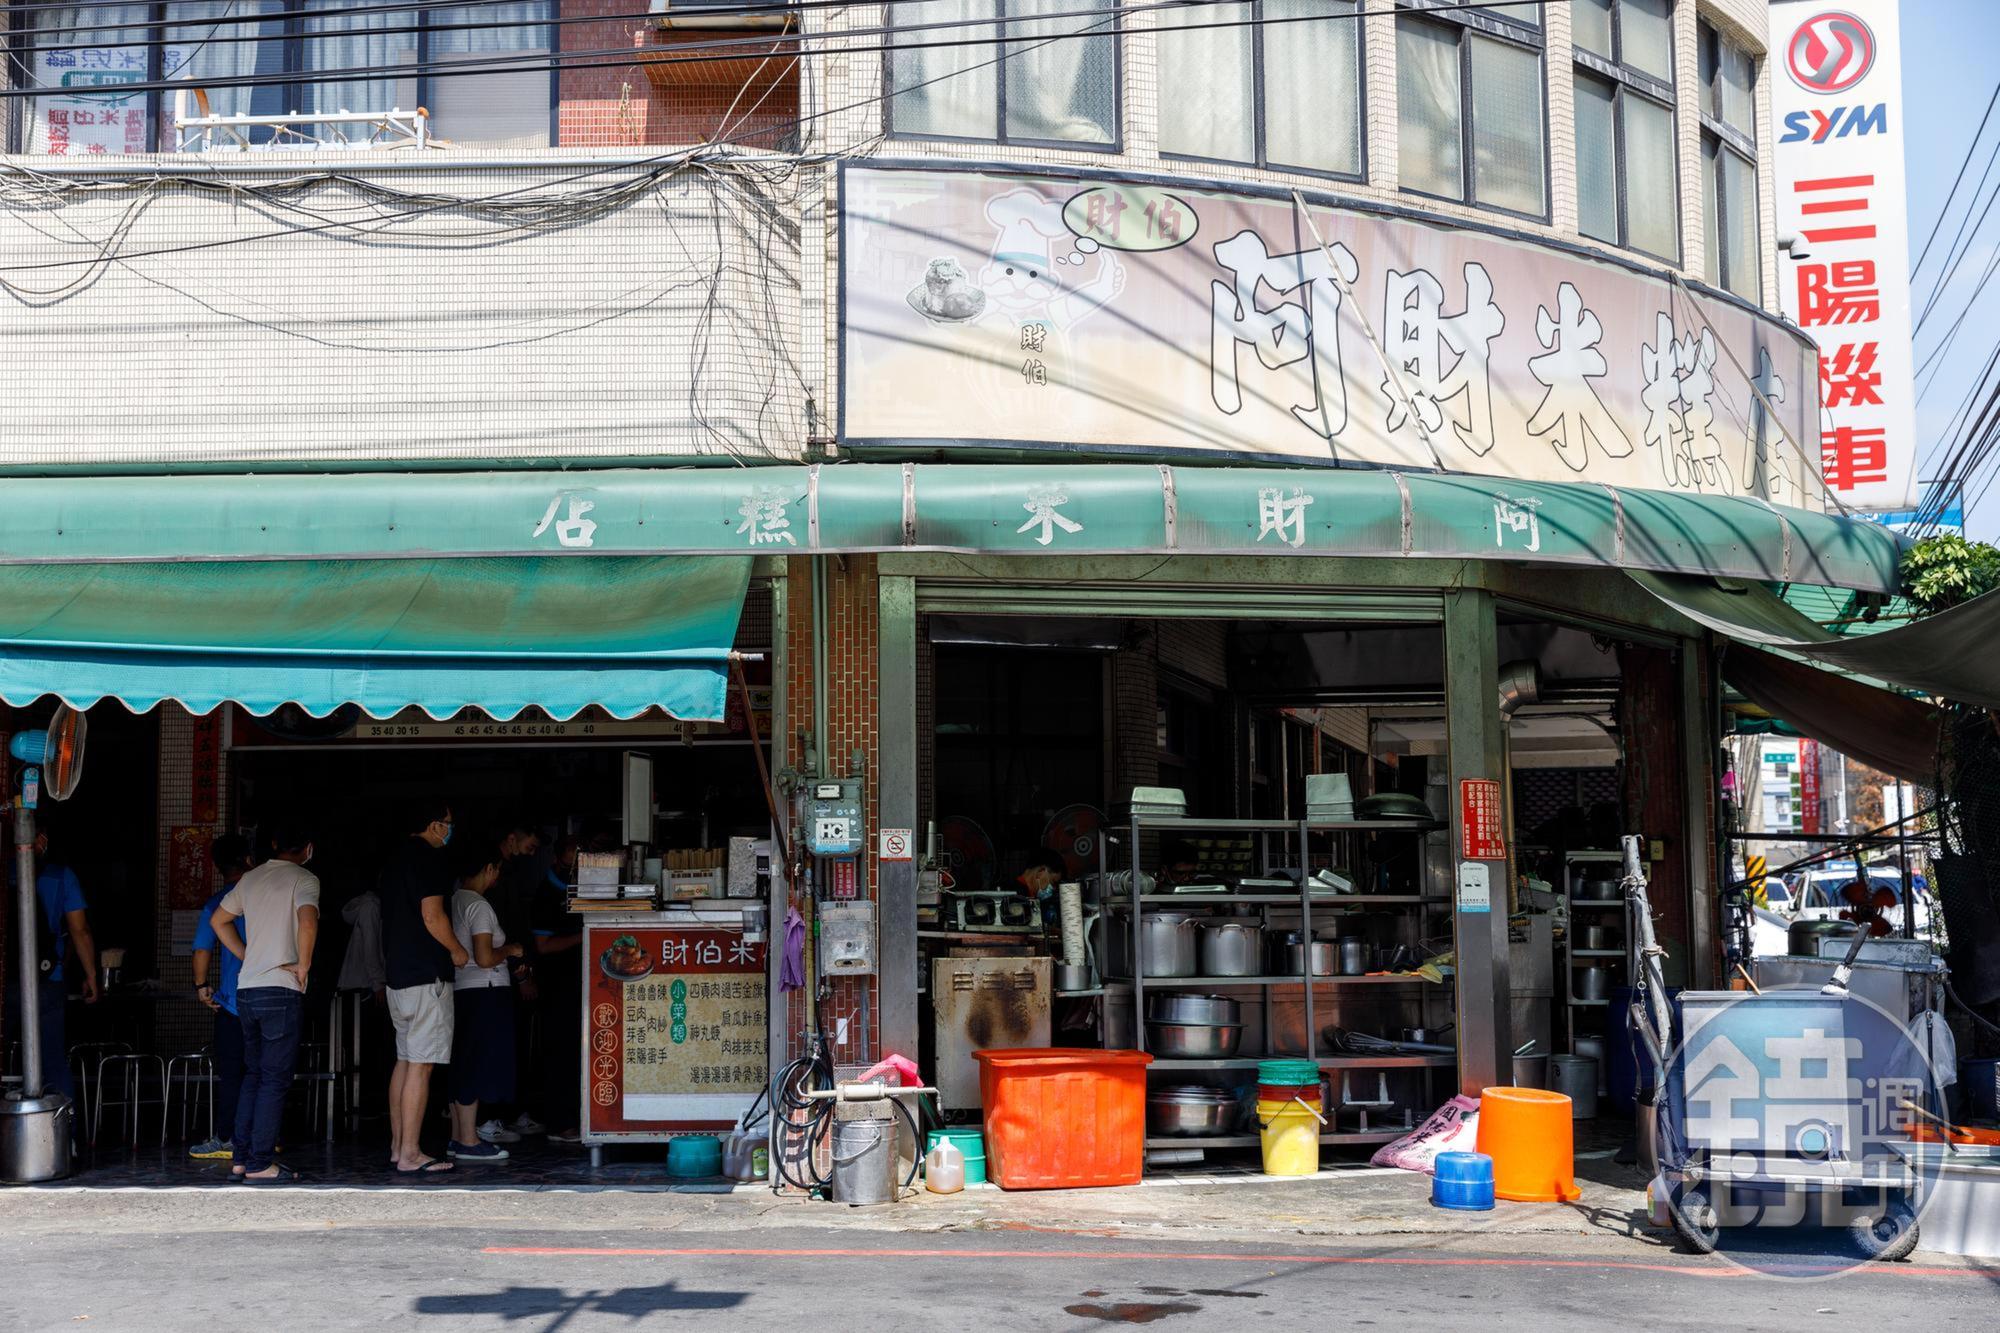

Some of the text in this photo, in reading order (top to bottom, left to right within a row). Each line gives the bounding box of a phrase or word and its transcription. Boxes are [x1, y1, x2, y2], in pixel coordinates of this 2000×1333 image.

[1779, 103, 1887, 144] SYM
[1085, 190, 1183, 242] 財伯
[1020, 325, 1048, 386] 財伯
[1793, 175, 1887, 491] 三陽機車
[1211, 229, 1786, 497] 阿財米糕店
[662, 938, 766, 965] 財伯米
[672, 983, 684, 1041] 小菜類
[596, 1005, 616, 1104] 歡迎光臨
